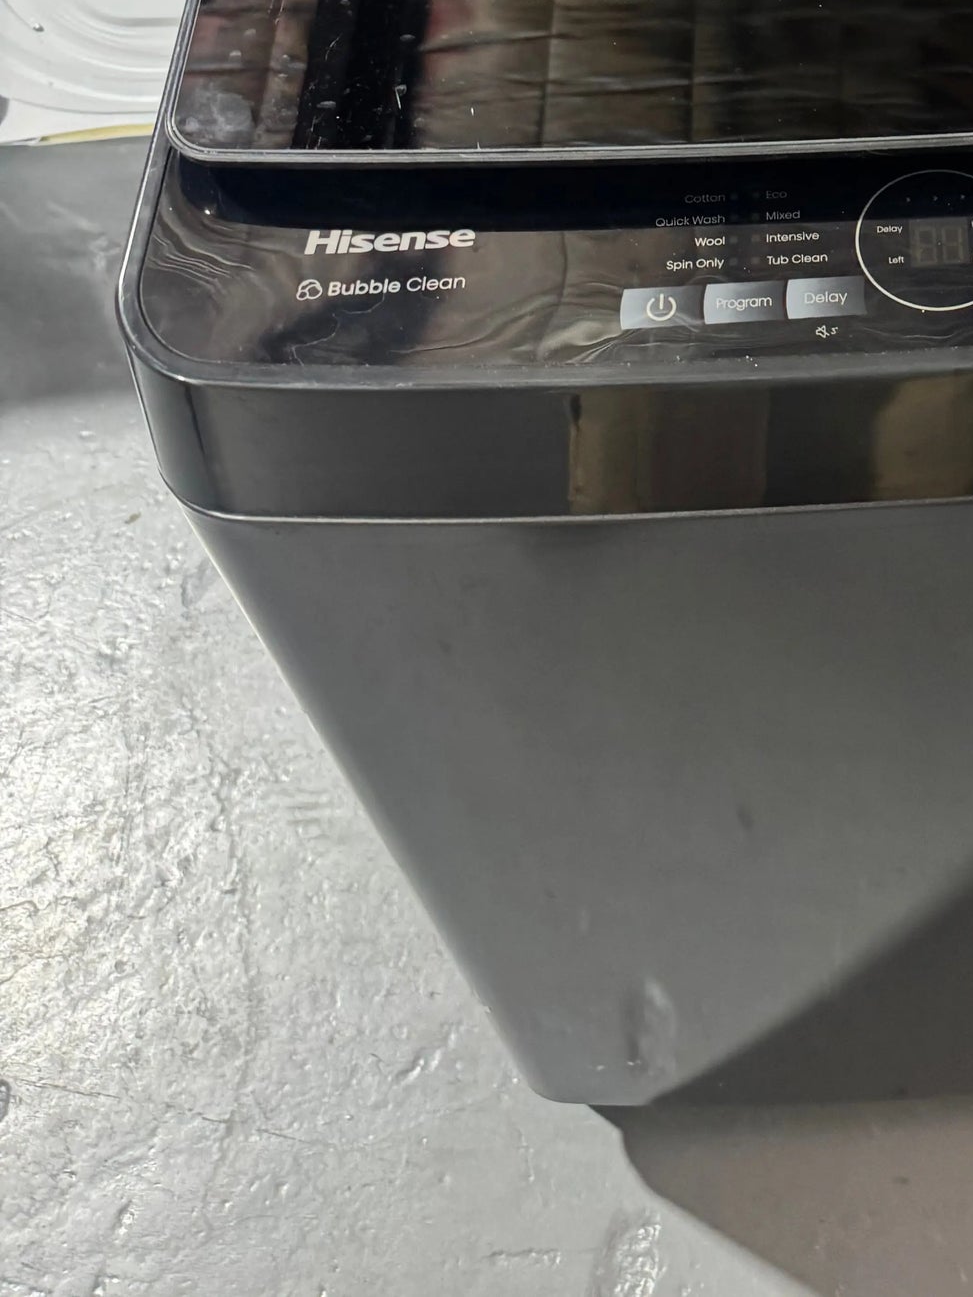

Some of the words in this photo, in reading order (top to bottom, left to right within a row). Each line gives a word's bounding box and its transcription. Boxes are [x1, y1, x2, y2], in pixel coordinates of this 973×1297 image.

[684, 192, 726, 203] Cotton
[766, 190, 787, 199] Eco
[655, 216, 690, 227] Quick
[692, 214, 726, 225] Wash
[766, 210, 801, 220] Mixed
[876, 225, 903, 234] Delay
[304, 229, 476, 255] Hisense
[695, 236, 726, 247] Wool
[766, 231, 820, 243] Intensive
[666, 259, 693, 272] Spin
[696, 257, 725, 269] Only
[767, 254, 789, 265] Tub
[791, 253, 828, 264] Clean
[888, 255, 905, 264] Left
[327, 278, 401, 297] Bubble
[406, 276, 466, 291] Clean
[716, 296, 773, 311] Program
[804, 292, 848, 305] Delay
